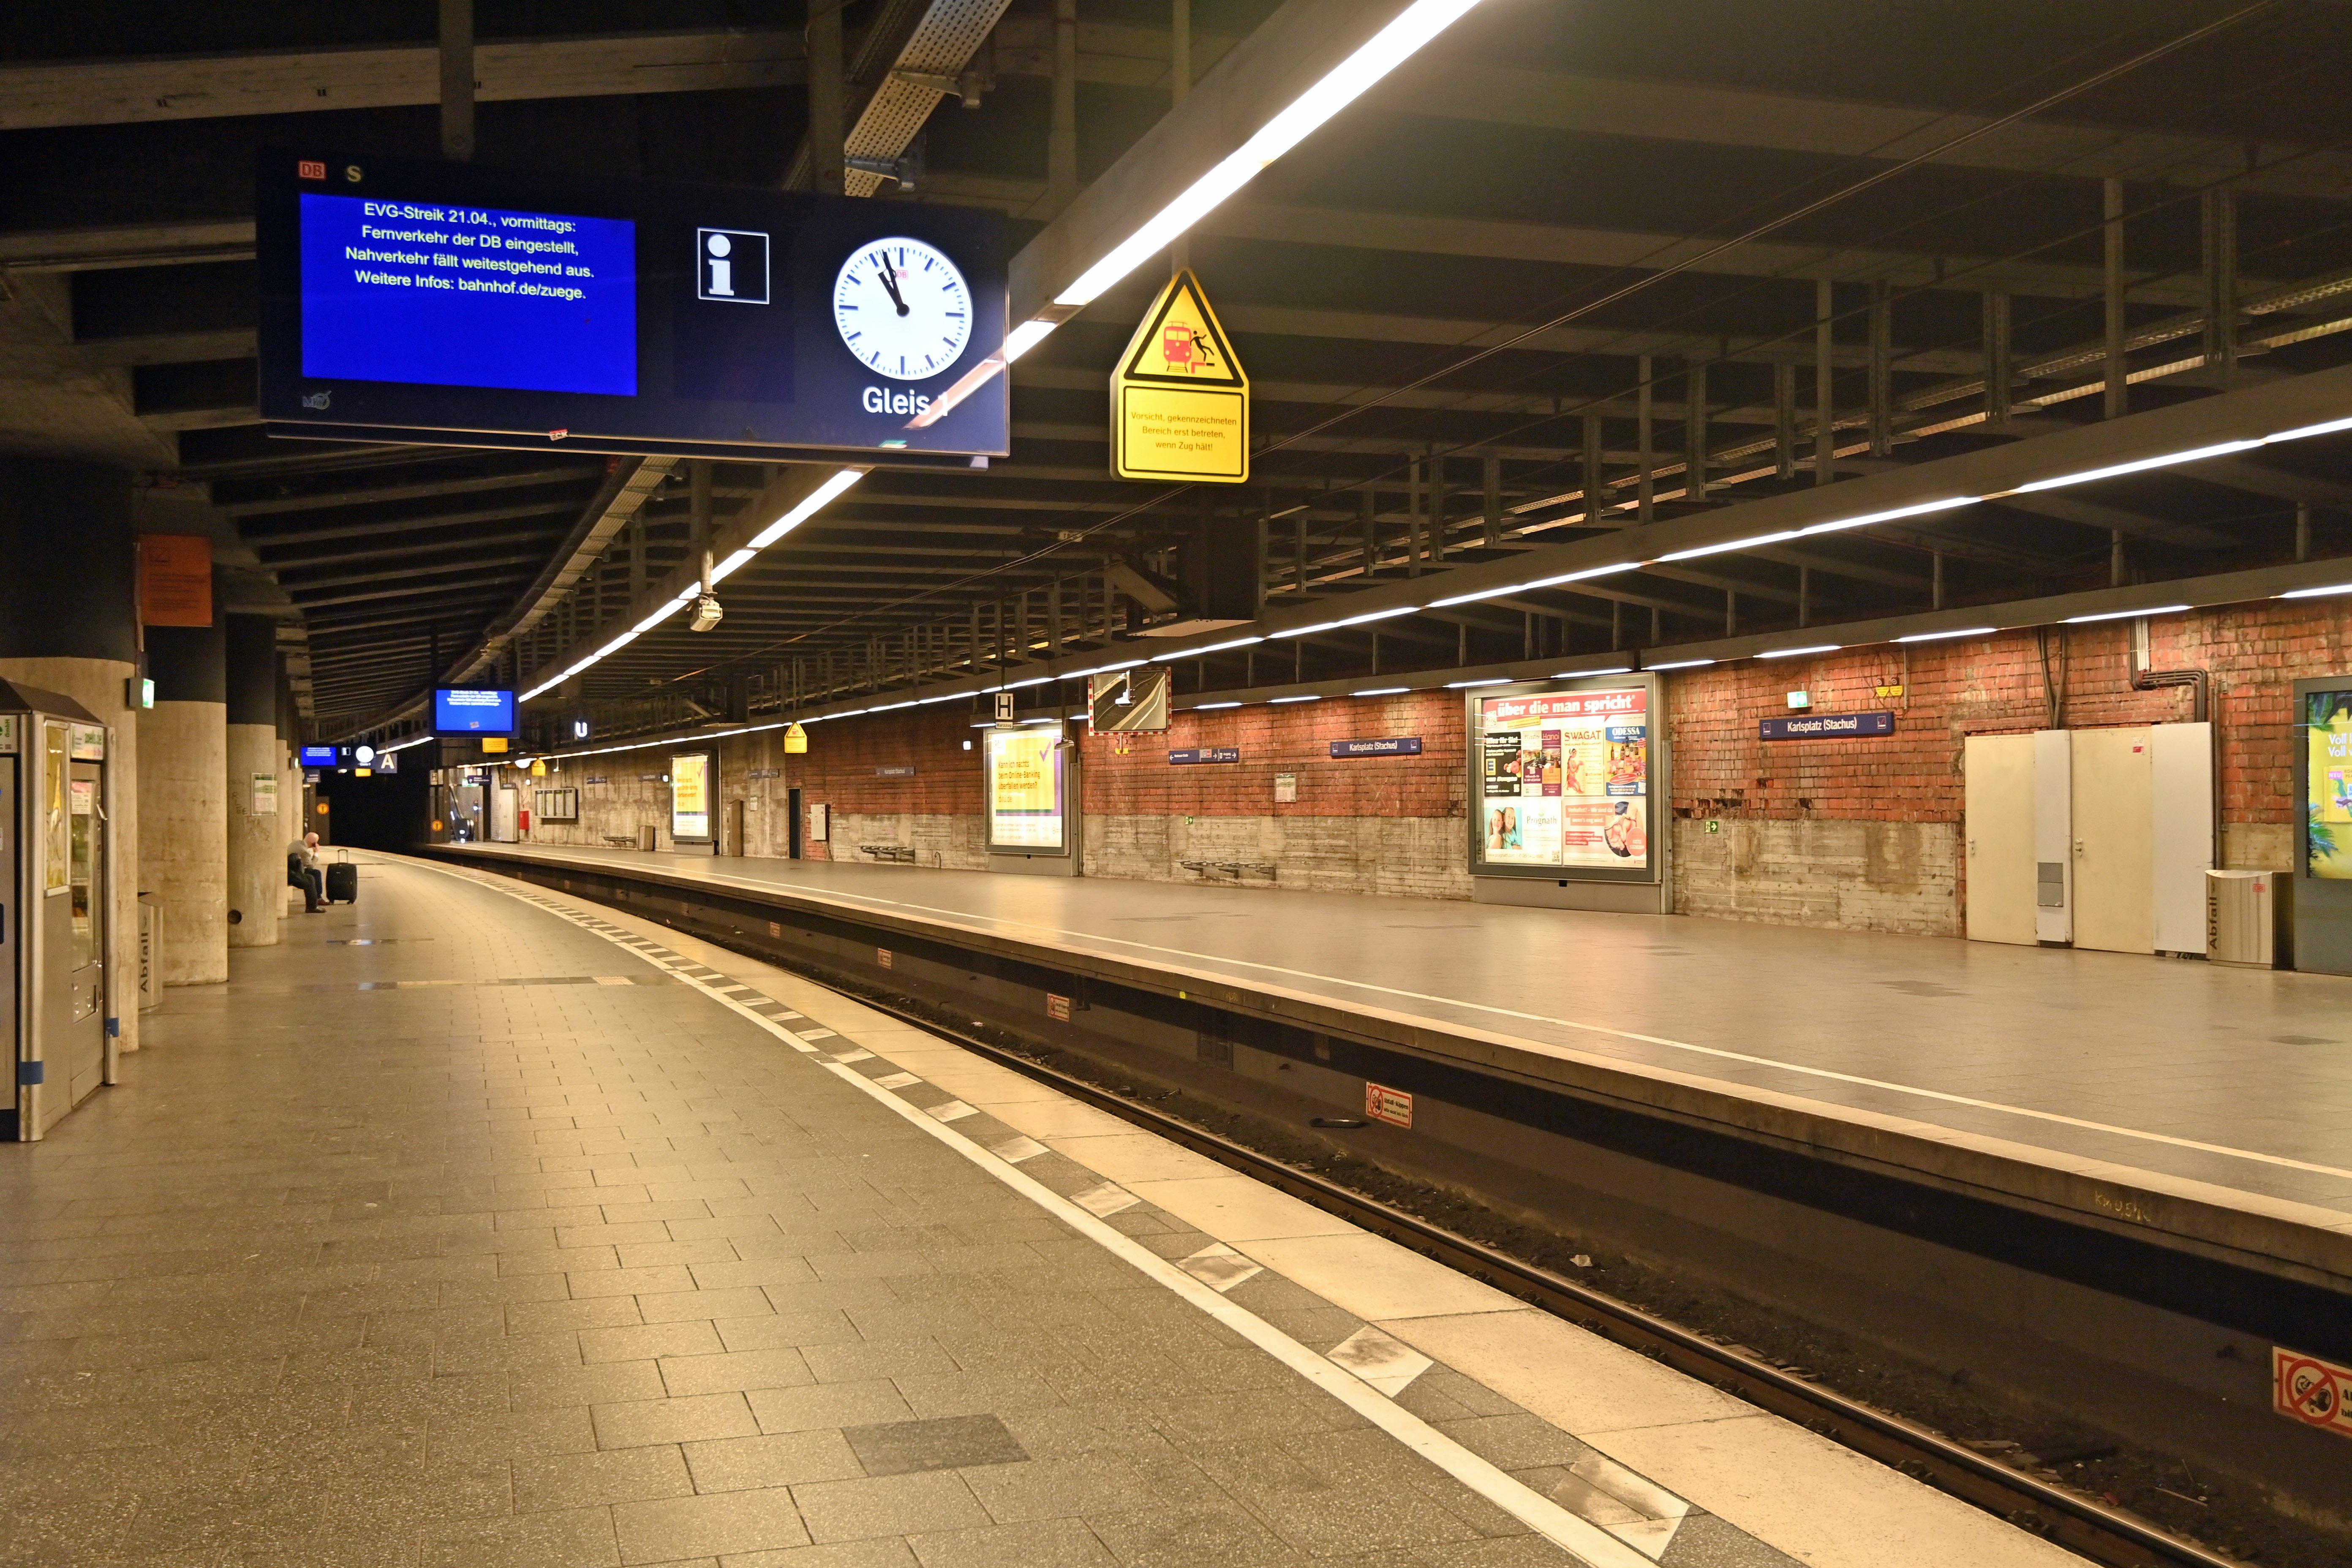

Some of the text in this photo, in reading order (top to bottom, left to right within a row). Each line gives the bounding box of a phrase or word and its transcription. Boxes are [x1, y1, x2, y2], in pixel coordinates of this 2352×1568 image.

[301, 162, 324, 178] DB
[364, 202, 576, 234] EVG-Streik 21.04., vormittags:
[362, 225, 579, 256] Fernverkehr der DB eingestellt,
[346, 246, 594, 278] Nahverkehr fällt weitestgehend aus.
[354, 270, 586, 301] Weitere Infos: bahnhof.de/zuege.
[863, 386, 948, 416] Gleis 1
[1131, 412, 1237, 425] Vorsicht, gekennzeichneten
[1142, 426, 1171, 435] Bereich
[1191, 429, 1225, 439] betreten,
[1179, 442, 1193, 451] Zug
[1195, 443, 1213, 451] hält!
[997, 696, 1011, 717] H
[1497, 702, 1526, 716] über
[1529, 700, 1549, 714] die
[1552, 701, 1580, 713] man
[576, 721, 588, 737] U
[1612, 727, 1640, 736] ODESSA
[1787, 716, 1858, 733] Karlsplatz (Stachus)
[1564, 730, 1601, 740] SWAGAT
[2328, 733, 2347, 745] Voll
[1349, 740, 1397, 752] Karlsplatz (Stachus)
[2328, 745, 2347, 757] Voll
[381, 754, 395, 769] A
[1527, 816, 1557, 827] Prognath
